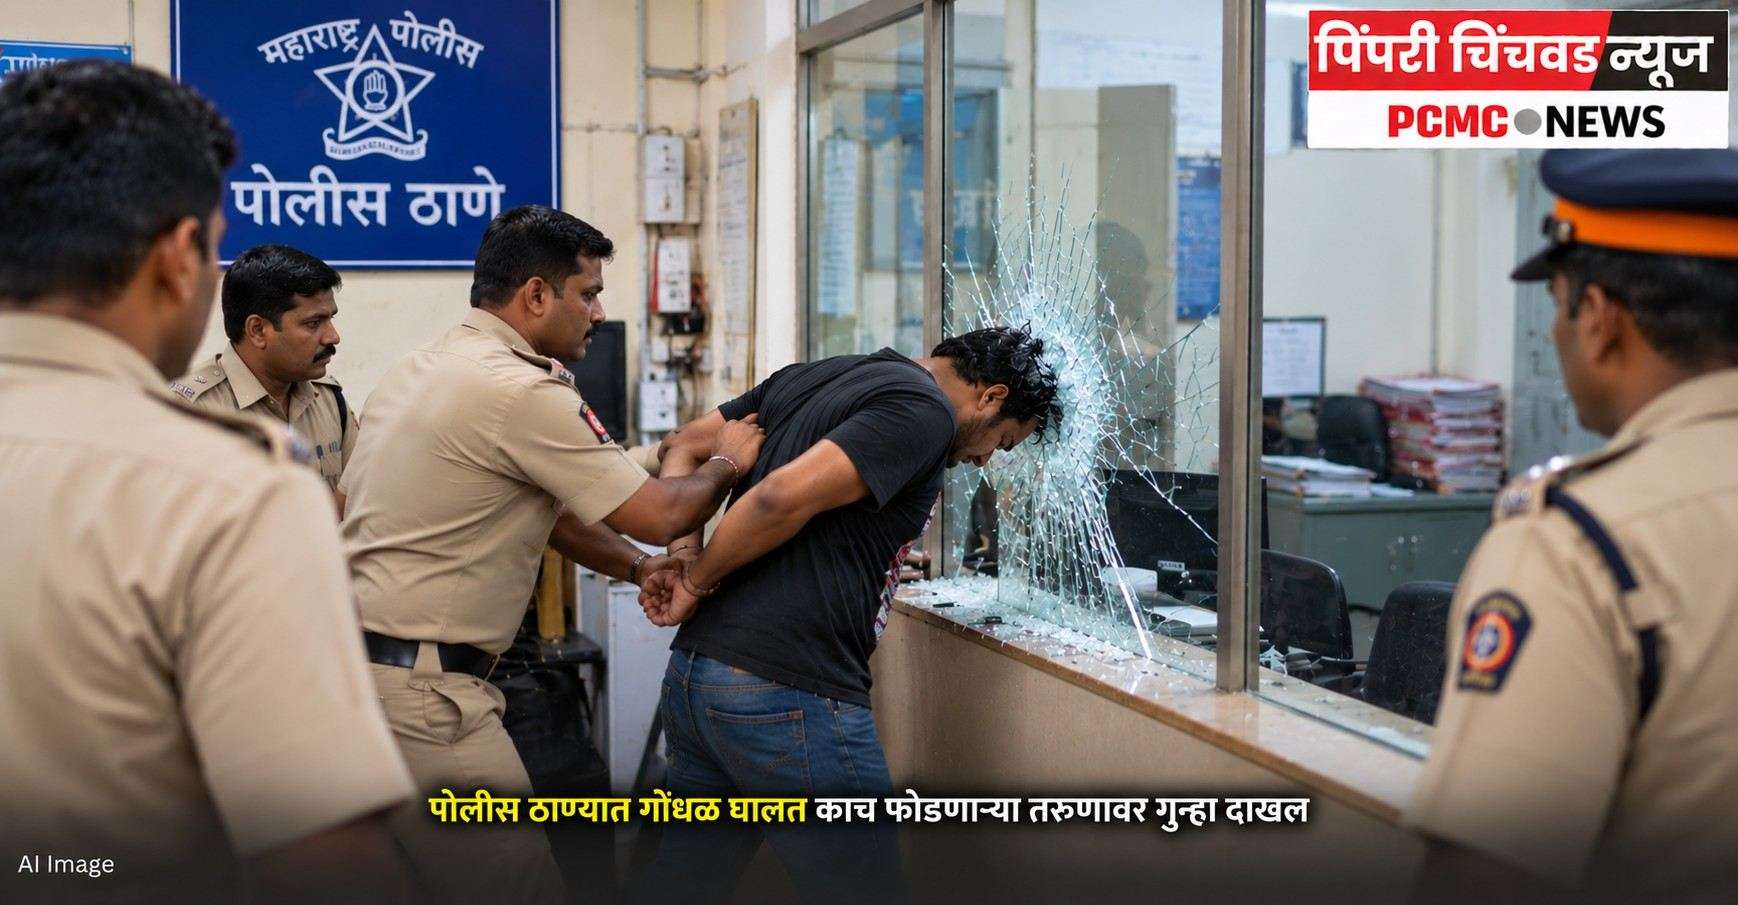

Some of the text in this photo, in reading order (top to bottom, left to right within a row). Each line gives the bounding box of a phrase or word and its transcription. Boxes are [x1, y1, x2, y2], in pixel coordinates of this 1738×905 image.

[257, 10, 484, 69] महाराष्ट्र पोलीस
[230, 163, 506, 227] पोलीस ठाणे
